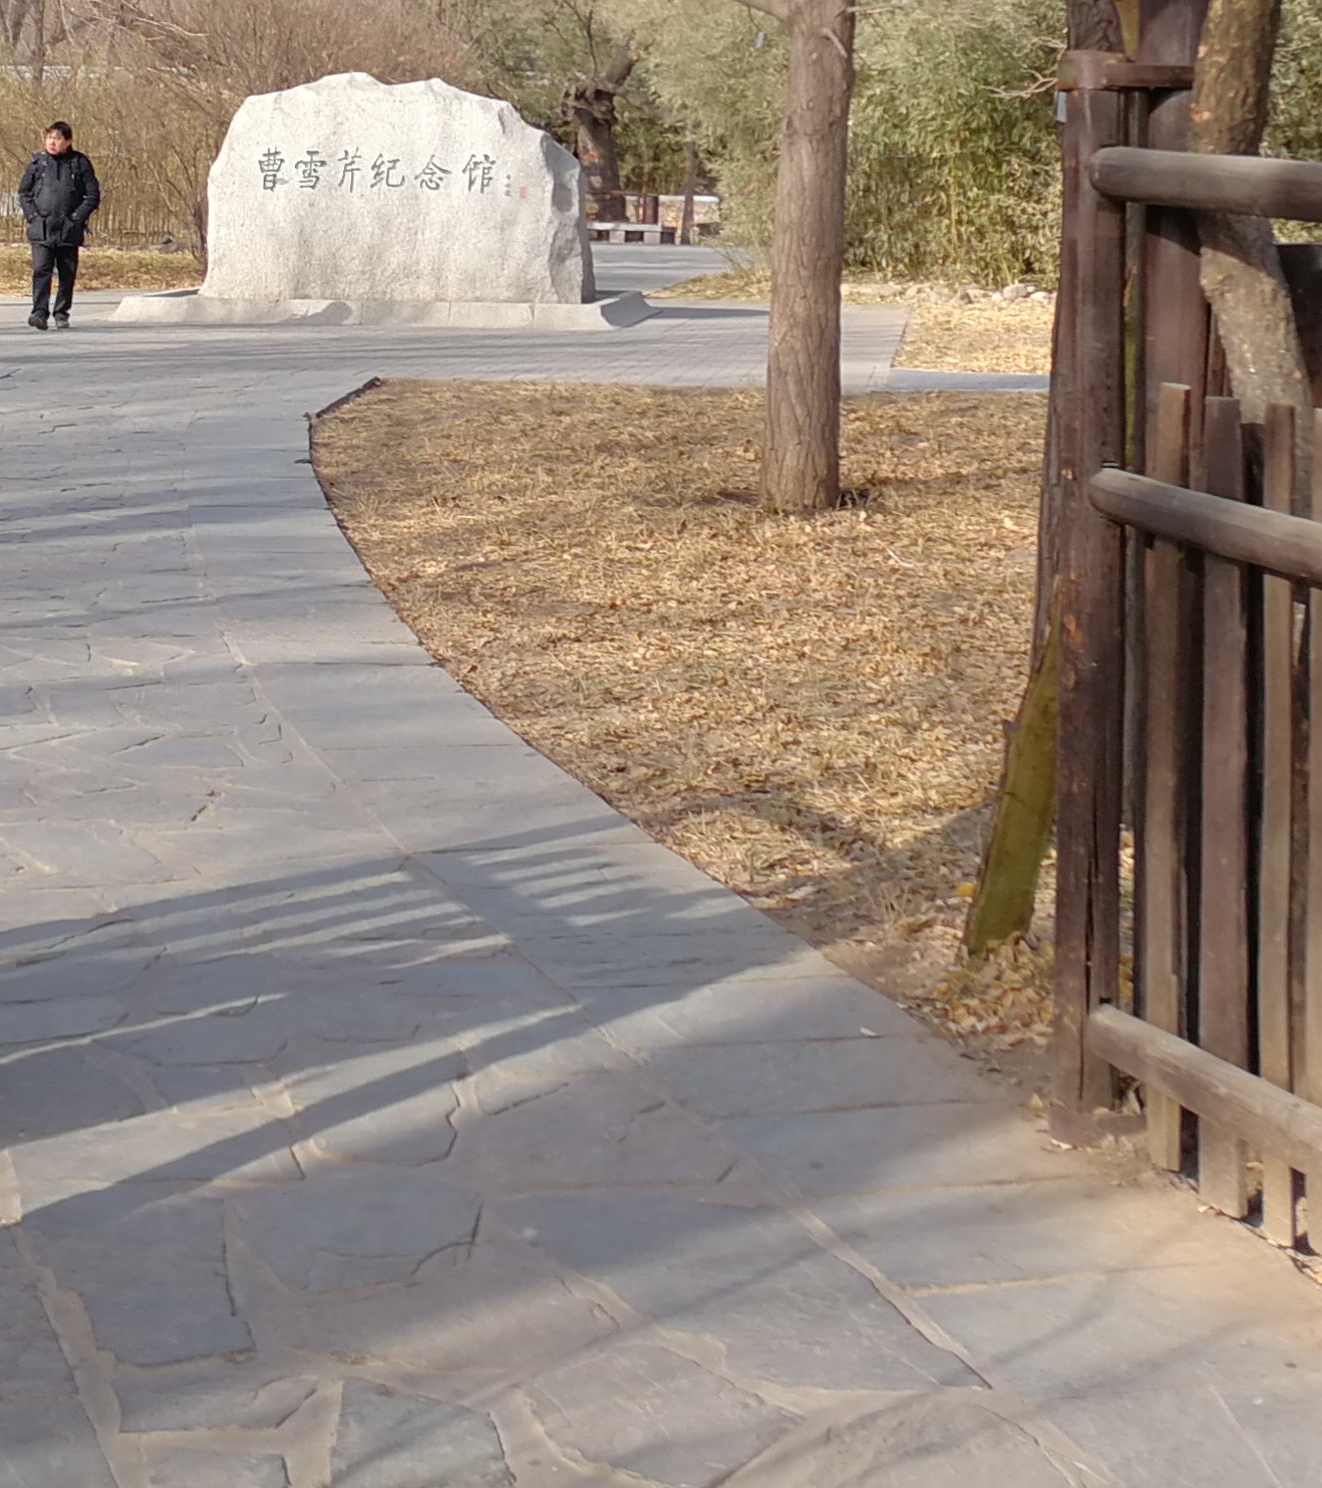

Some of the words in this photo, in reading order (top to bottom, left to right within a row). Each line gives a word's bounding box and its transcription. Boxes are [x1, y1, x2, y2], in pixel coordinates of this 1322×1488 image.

[257, 147, 496, 194] 曹雪芹纪念馆
